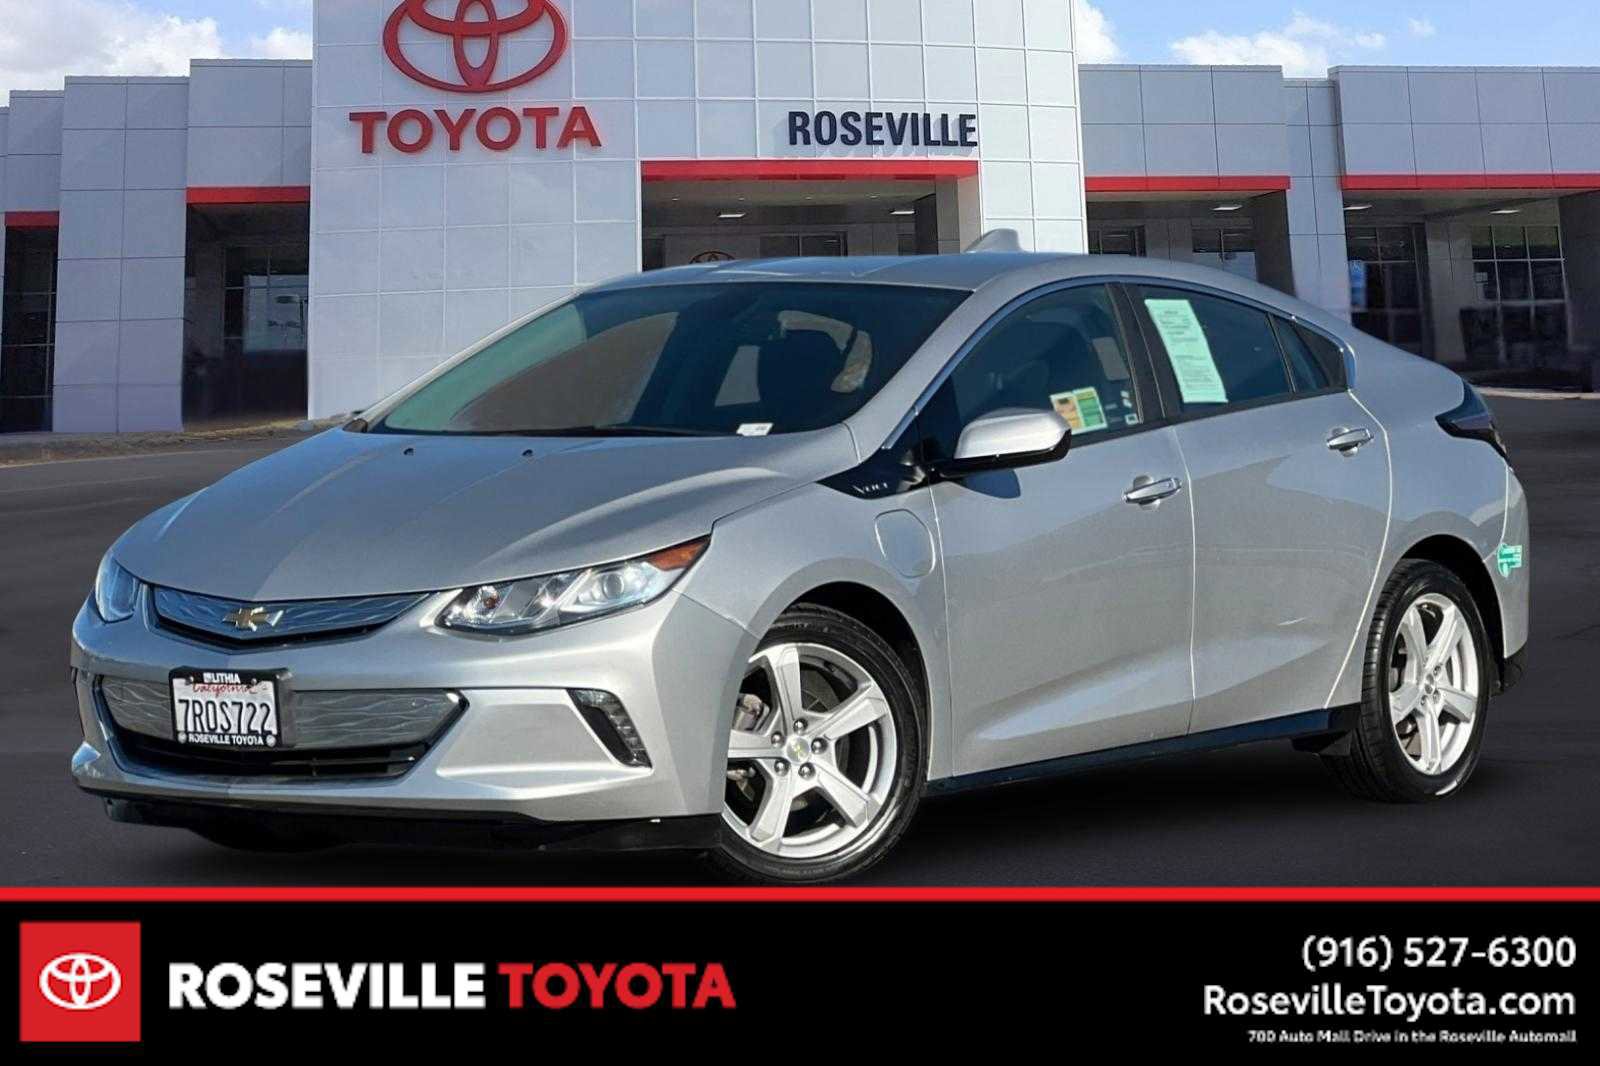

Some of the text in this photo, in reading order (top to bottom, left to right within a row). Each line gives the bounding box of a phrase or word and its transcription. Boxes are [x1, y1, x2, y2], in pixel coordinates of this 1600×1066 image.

[349, 106, 602, 154] TOYOTA
[788, 111, 978, 147] ROSEVILLE
[178, 699, 273, 736] 7ROS722
[188, 733, 264, 746] ROSEVILLE TOYOTA
